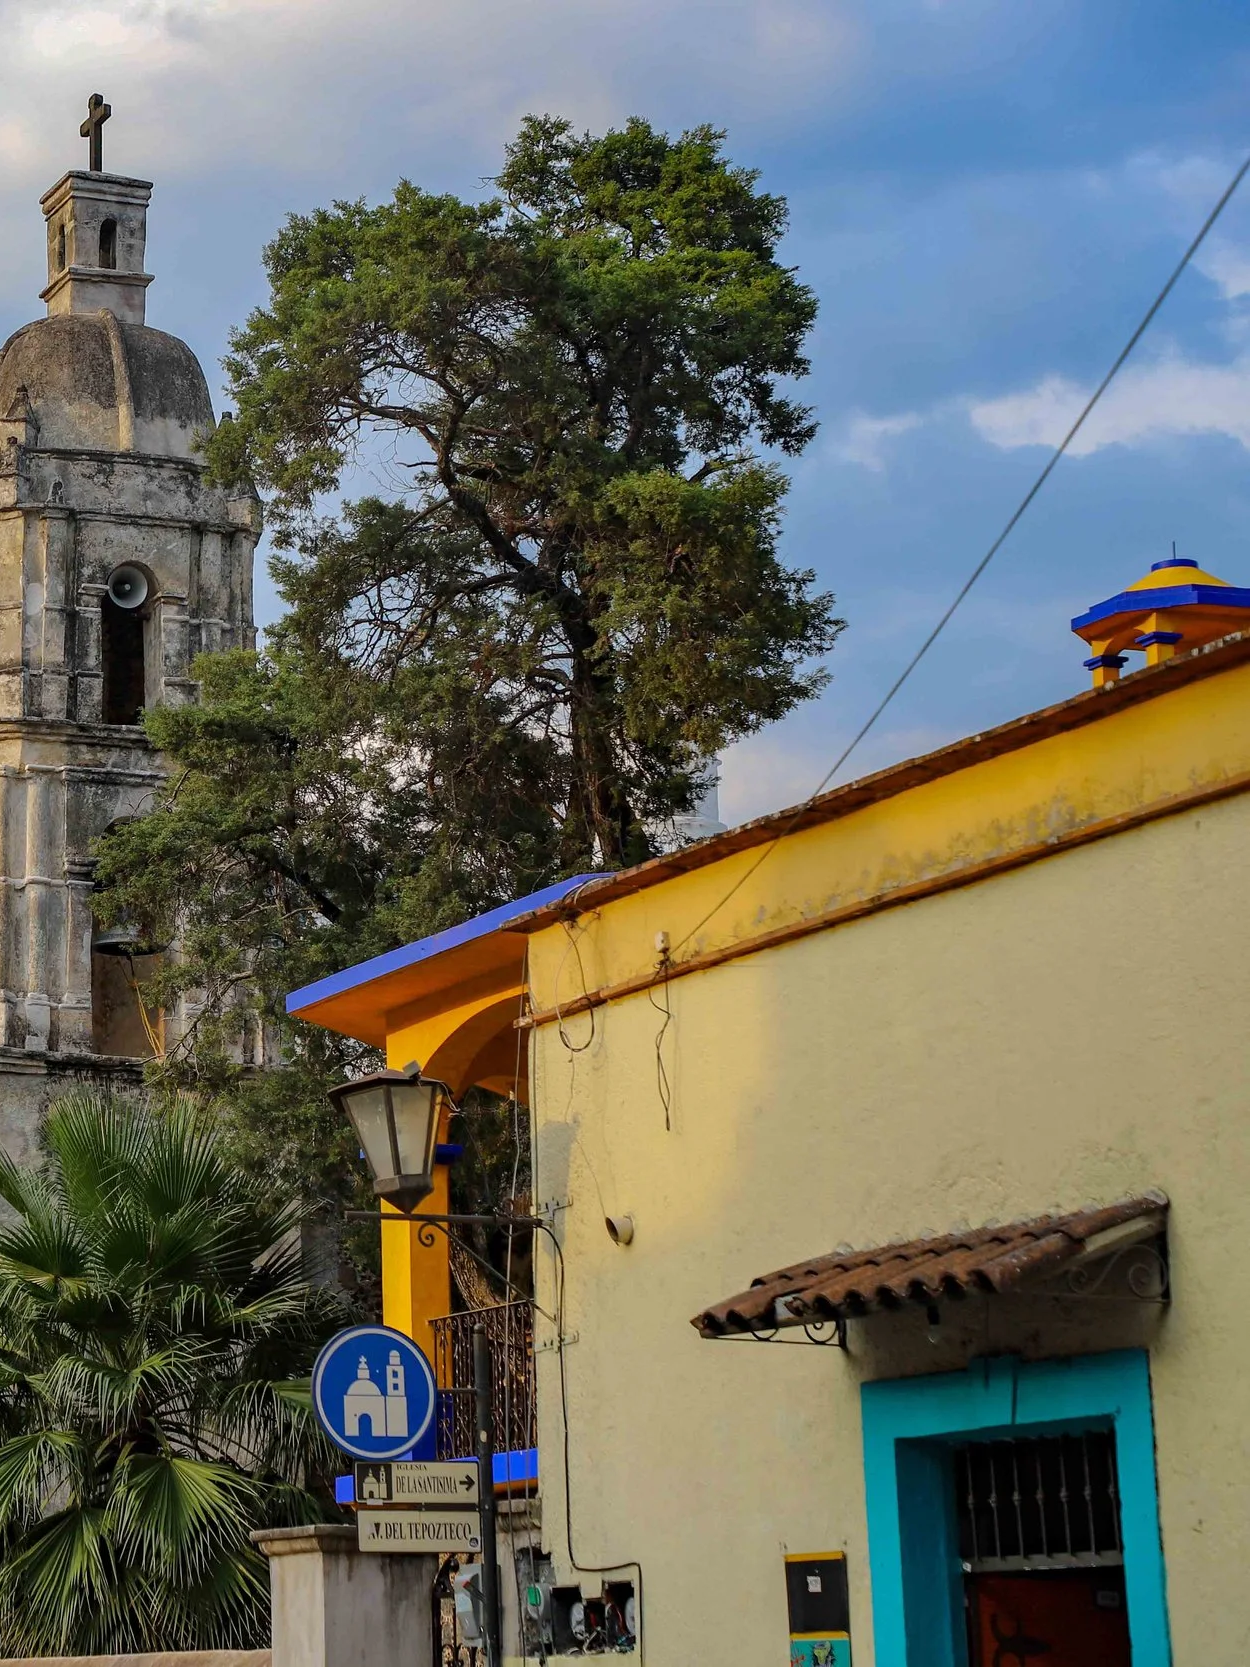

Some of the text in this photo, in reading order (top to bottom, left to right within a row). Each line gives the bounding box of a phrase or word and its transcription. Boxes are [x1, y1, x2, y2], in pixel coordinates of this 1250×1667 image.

[396, 1463, 427, 1471] IGLESIA
[396, 1475, 406, 1494] DE
[385, 1522, 406, 1540] DEL
[407, 1522, 472, 1541] TEPOZTECO
